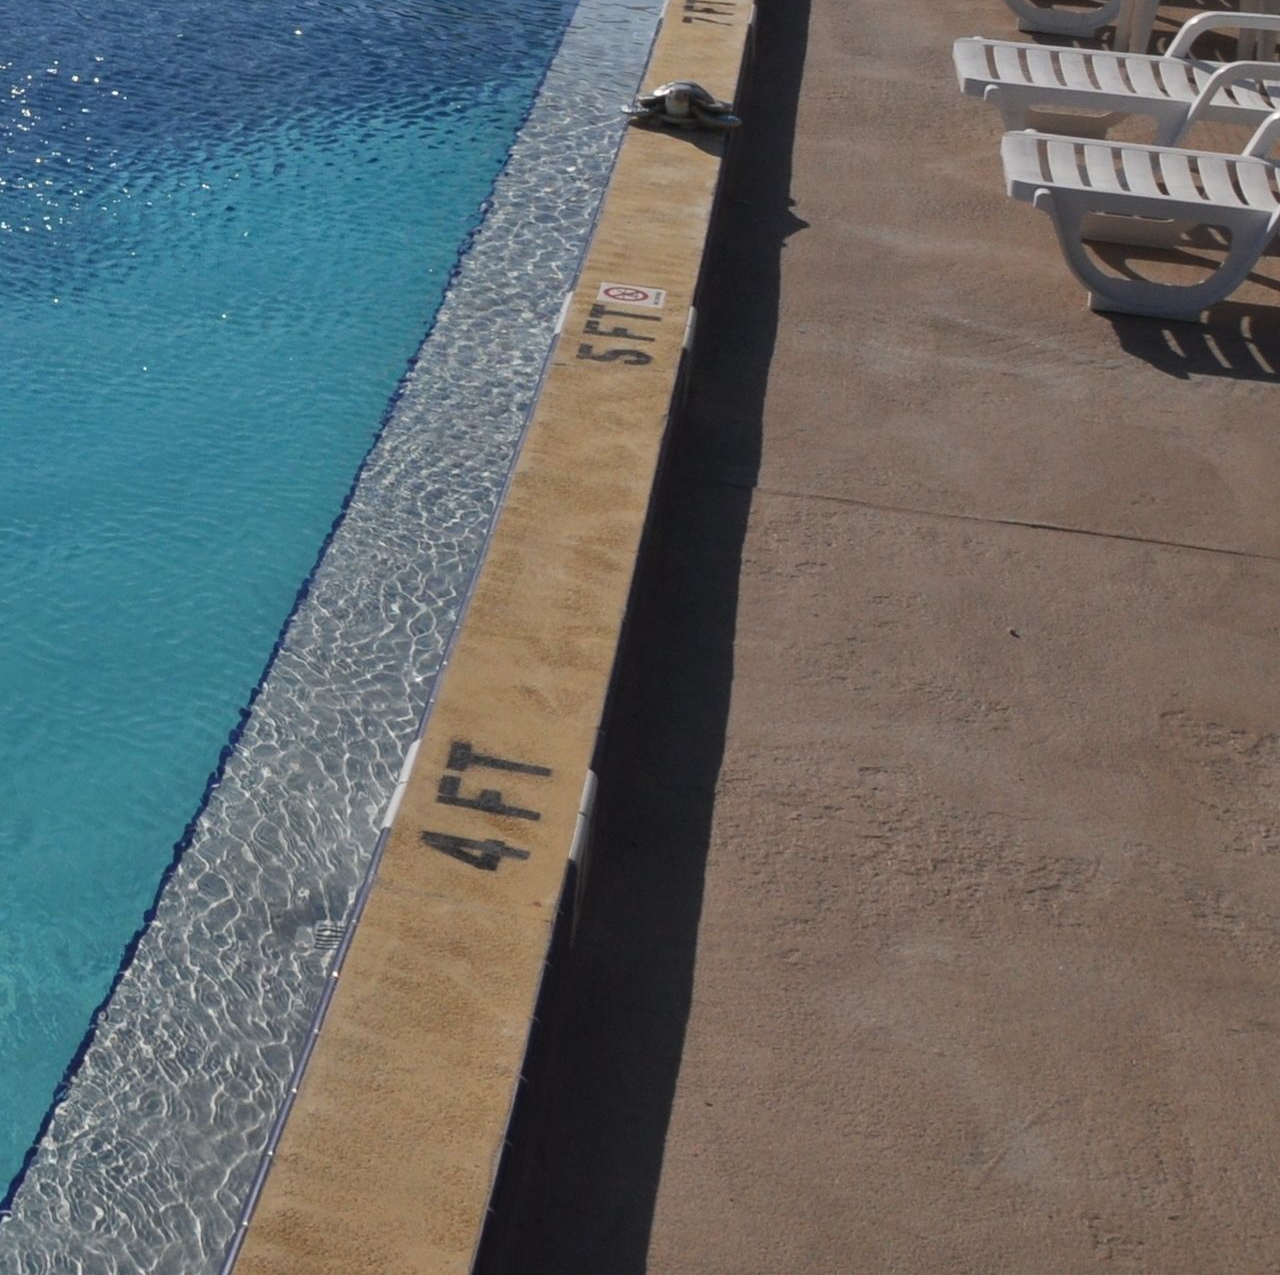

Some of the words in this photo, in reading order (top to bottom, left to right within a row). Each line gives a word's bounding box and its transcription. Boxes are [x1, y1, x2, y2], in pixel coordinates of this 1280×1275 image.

[682, 15, 734, 27] 7
[582, 303, 663, 343] FT
[576, 342, 653, 366] 5
[436, 739, 553, 822] FT
[421, 830, 531, 872] 4
